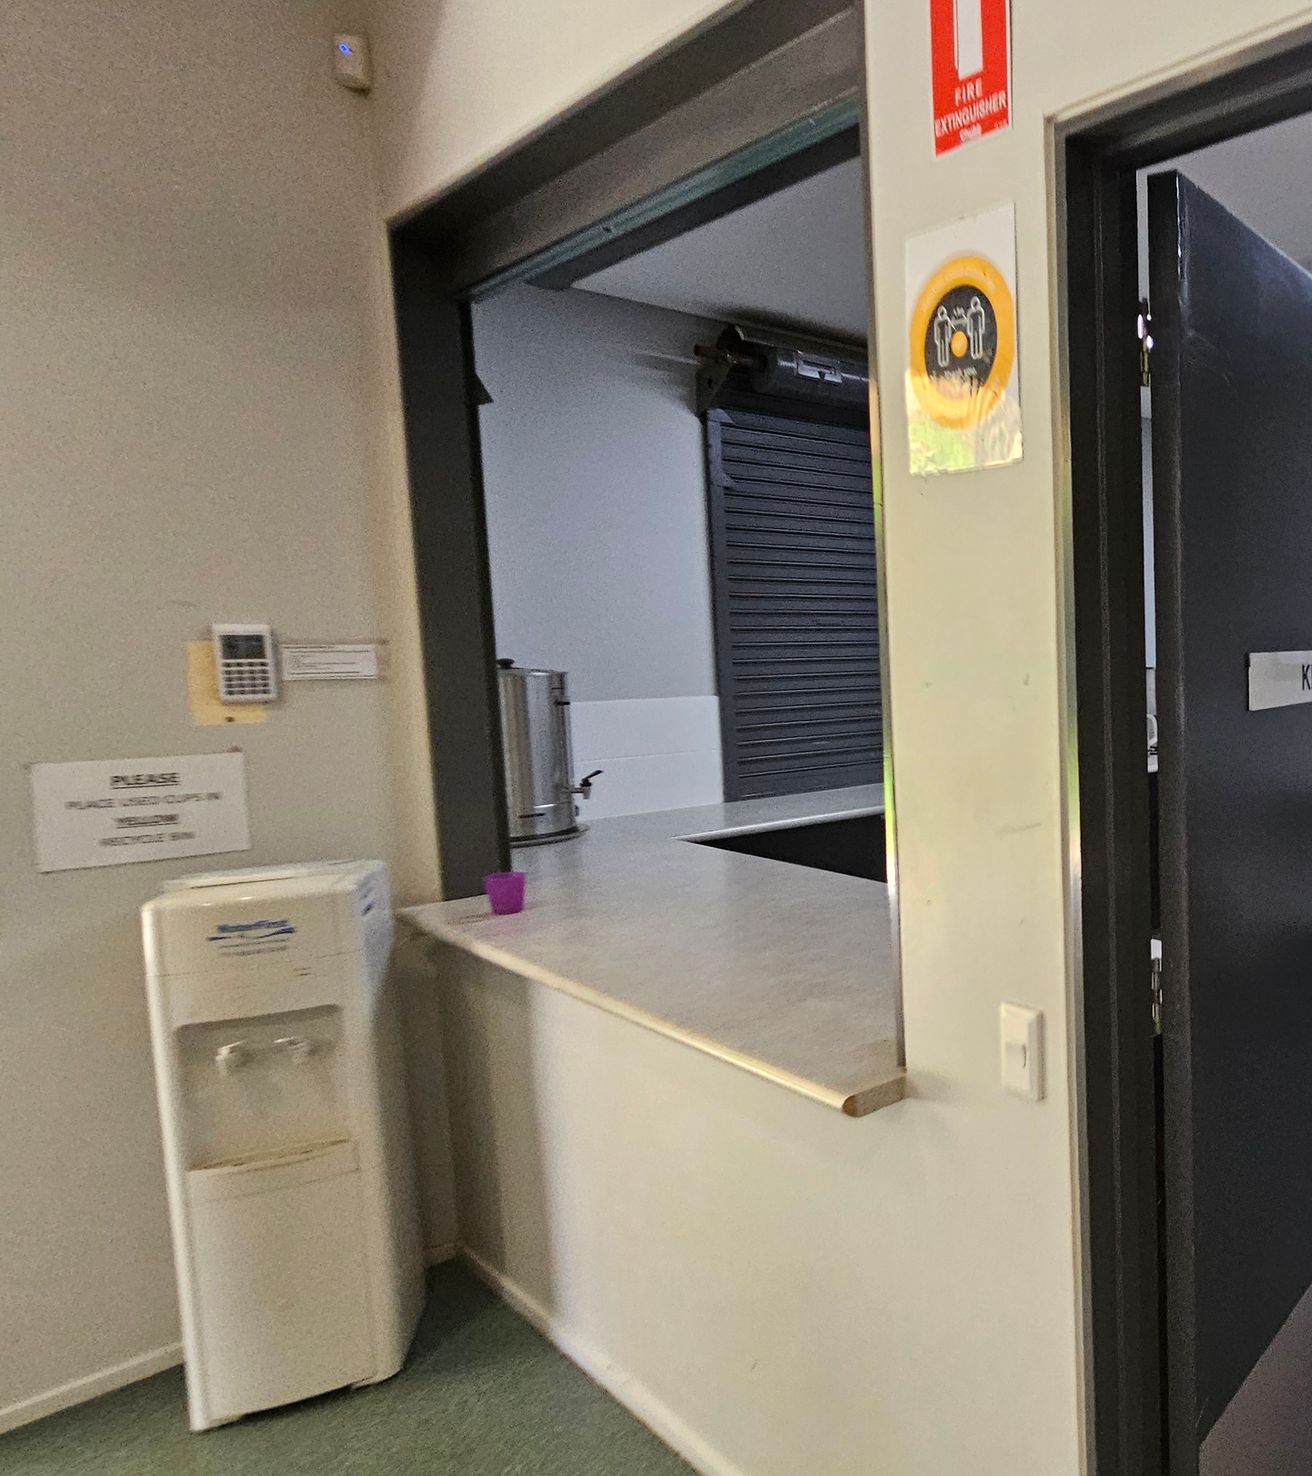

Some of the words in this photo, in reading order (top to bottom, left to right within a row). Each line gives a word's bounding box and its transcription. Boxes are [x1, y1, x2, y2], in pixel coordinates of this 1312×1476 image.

[954, 77, 982, 107] FIRE
[934, 90, 1007, 138] EXTINGUISHER
[110, 772, 181, 787] PLEASE
